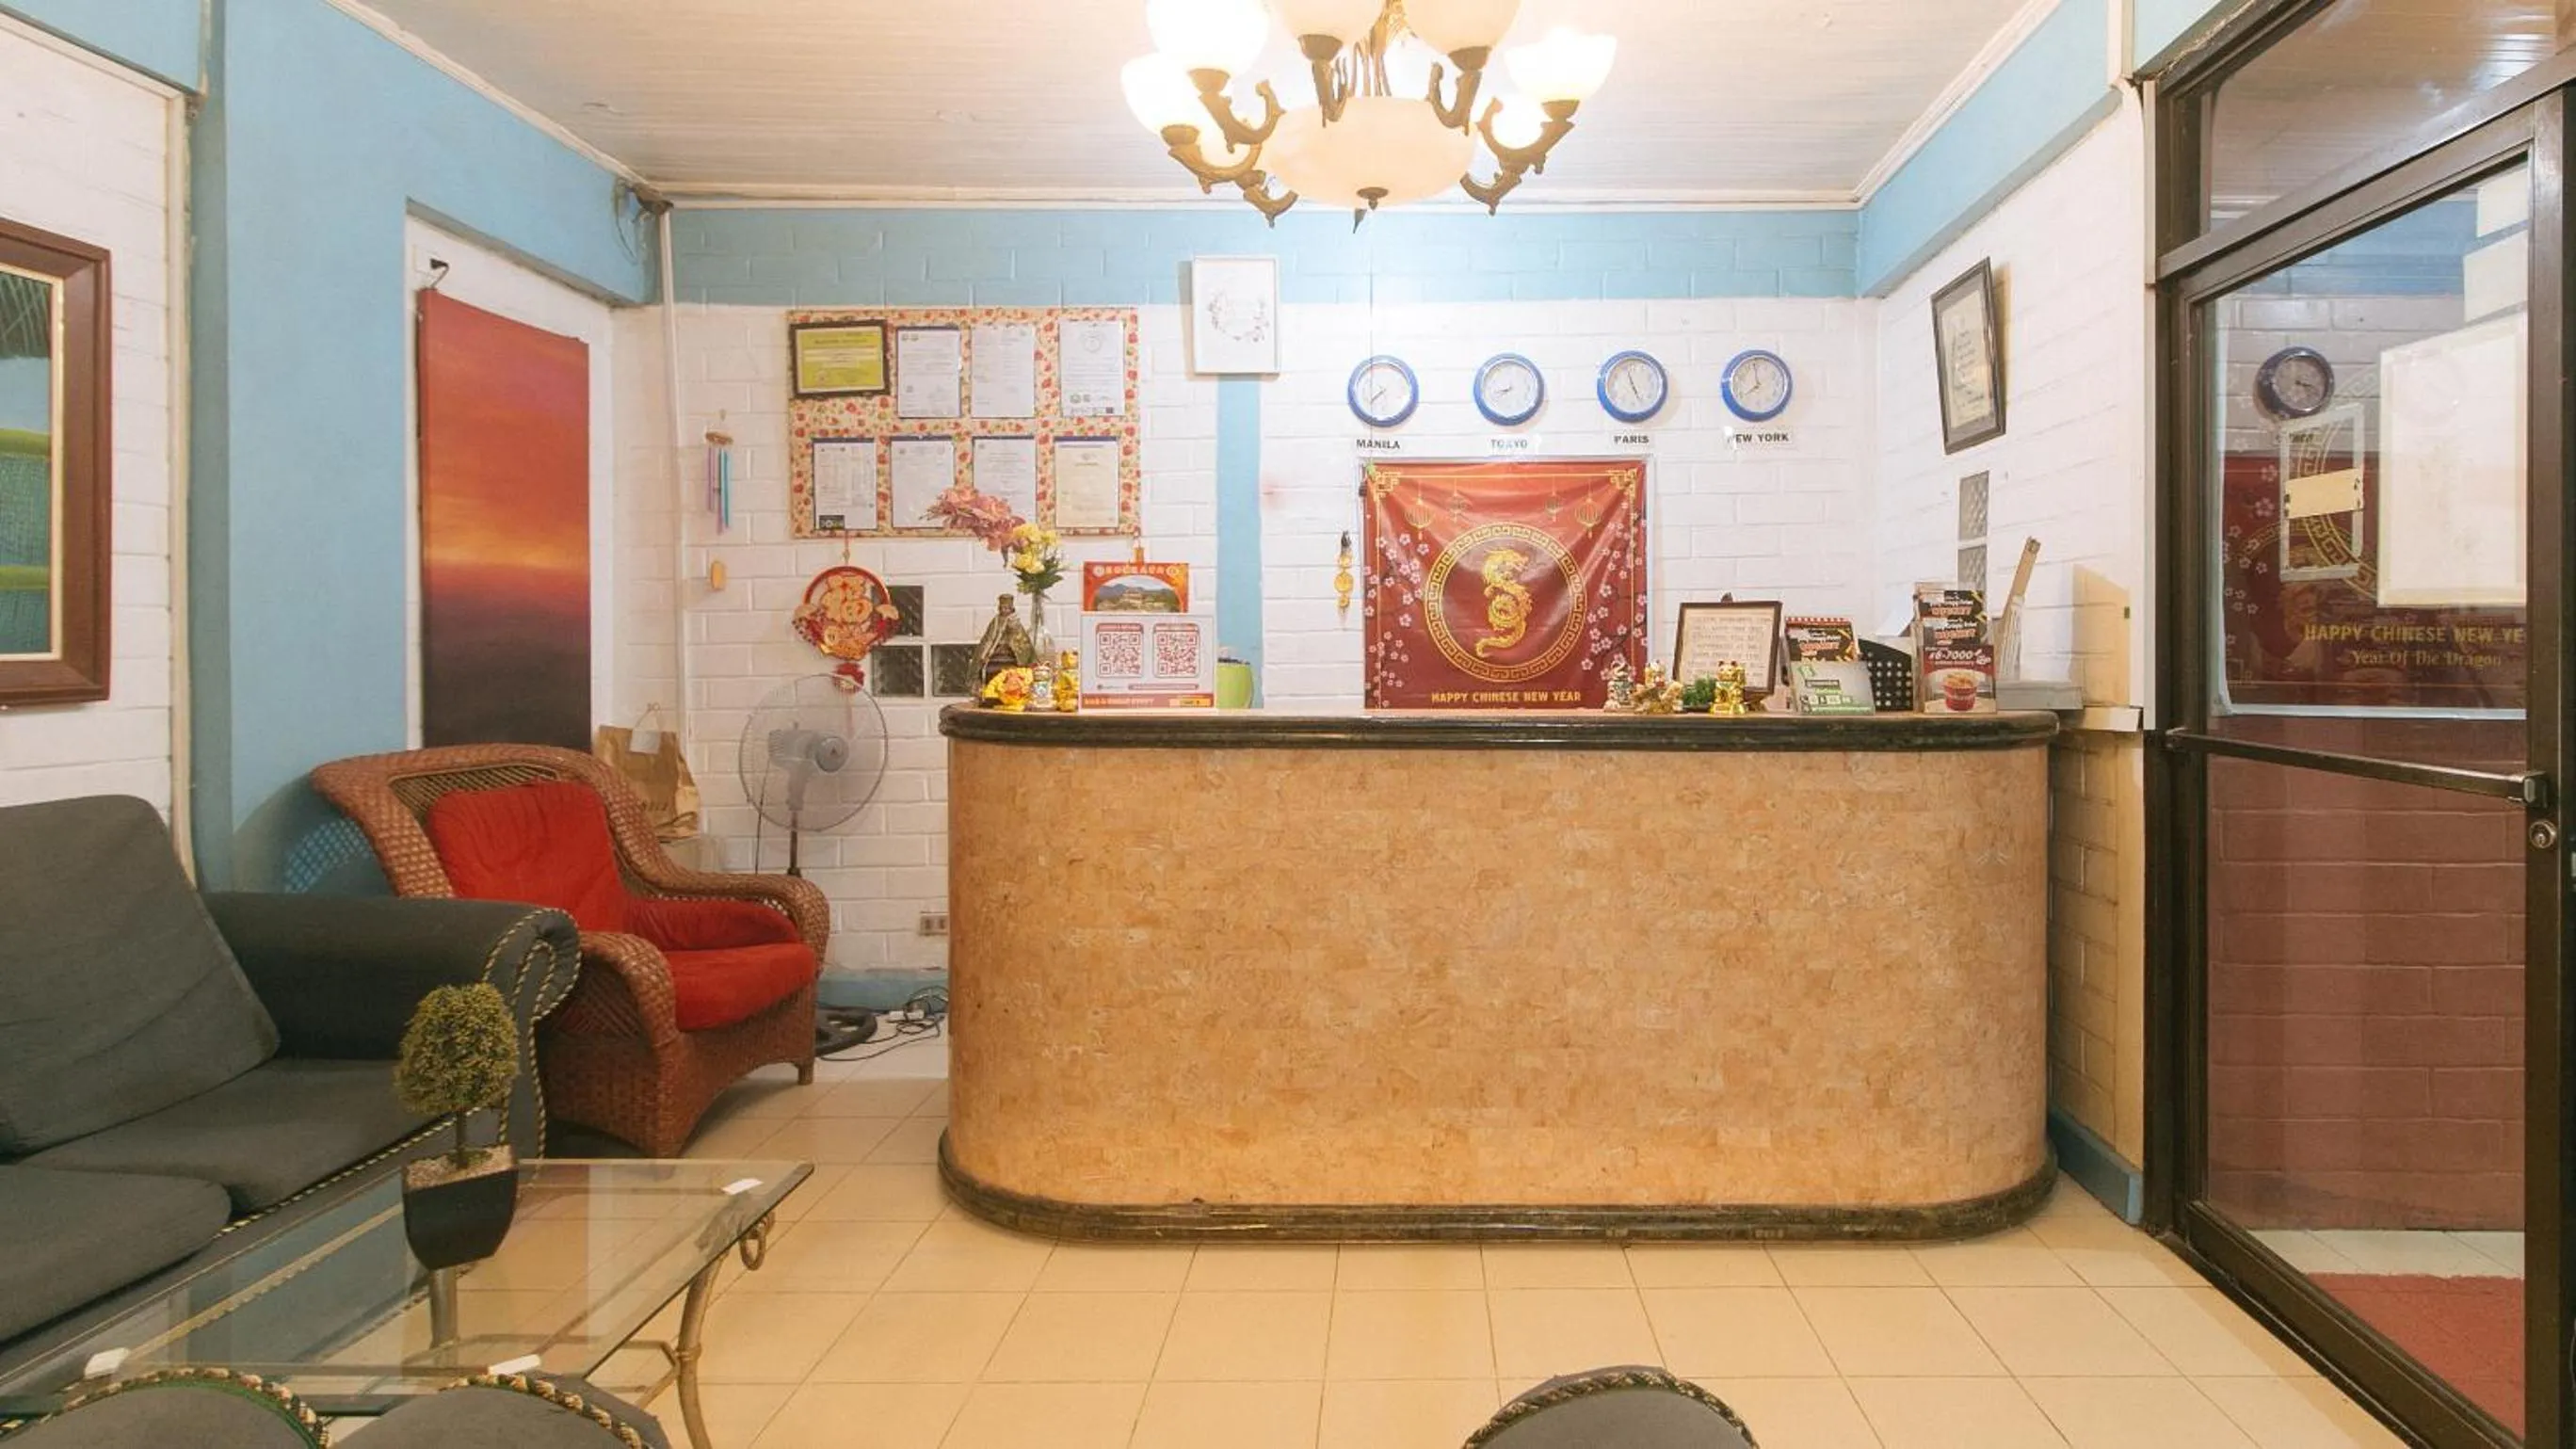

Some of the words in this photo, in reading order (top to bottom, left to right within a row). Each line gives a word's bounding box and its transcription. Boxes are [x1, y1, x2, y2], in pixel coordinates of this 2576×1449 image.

[1614, 435, 1650, 443] PARIS
[1728, 433, 1753, 443] EW
[1758, 433, 1789, 442] YORK
[1356, 439, 1400, 449] MANILA
[1490, 439, 1528, 449] TOYO
[2305, 624, 2361, 641] HAPPY
[2371, 625, 2446, 642] CHINESE
[2454, 626, 2493, 644] NEW
[2503, 628, 2525, 644] YE
[2391, 652, 2407, 666] Of
[2446, 652, 2502, 669] Dragon
[1431, 693, 1468, 703] HAPPY
[1473, 692, 1519, 702] CHINESE
[1523, 692, 1548, 701] NEW
[1554, 692, 1582, 701] YEAR
